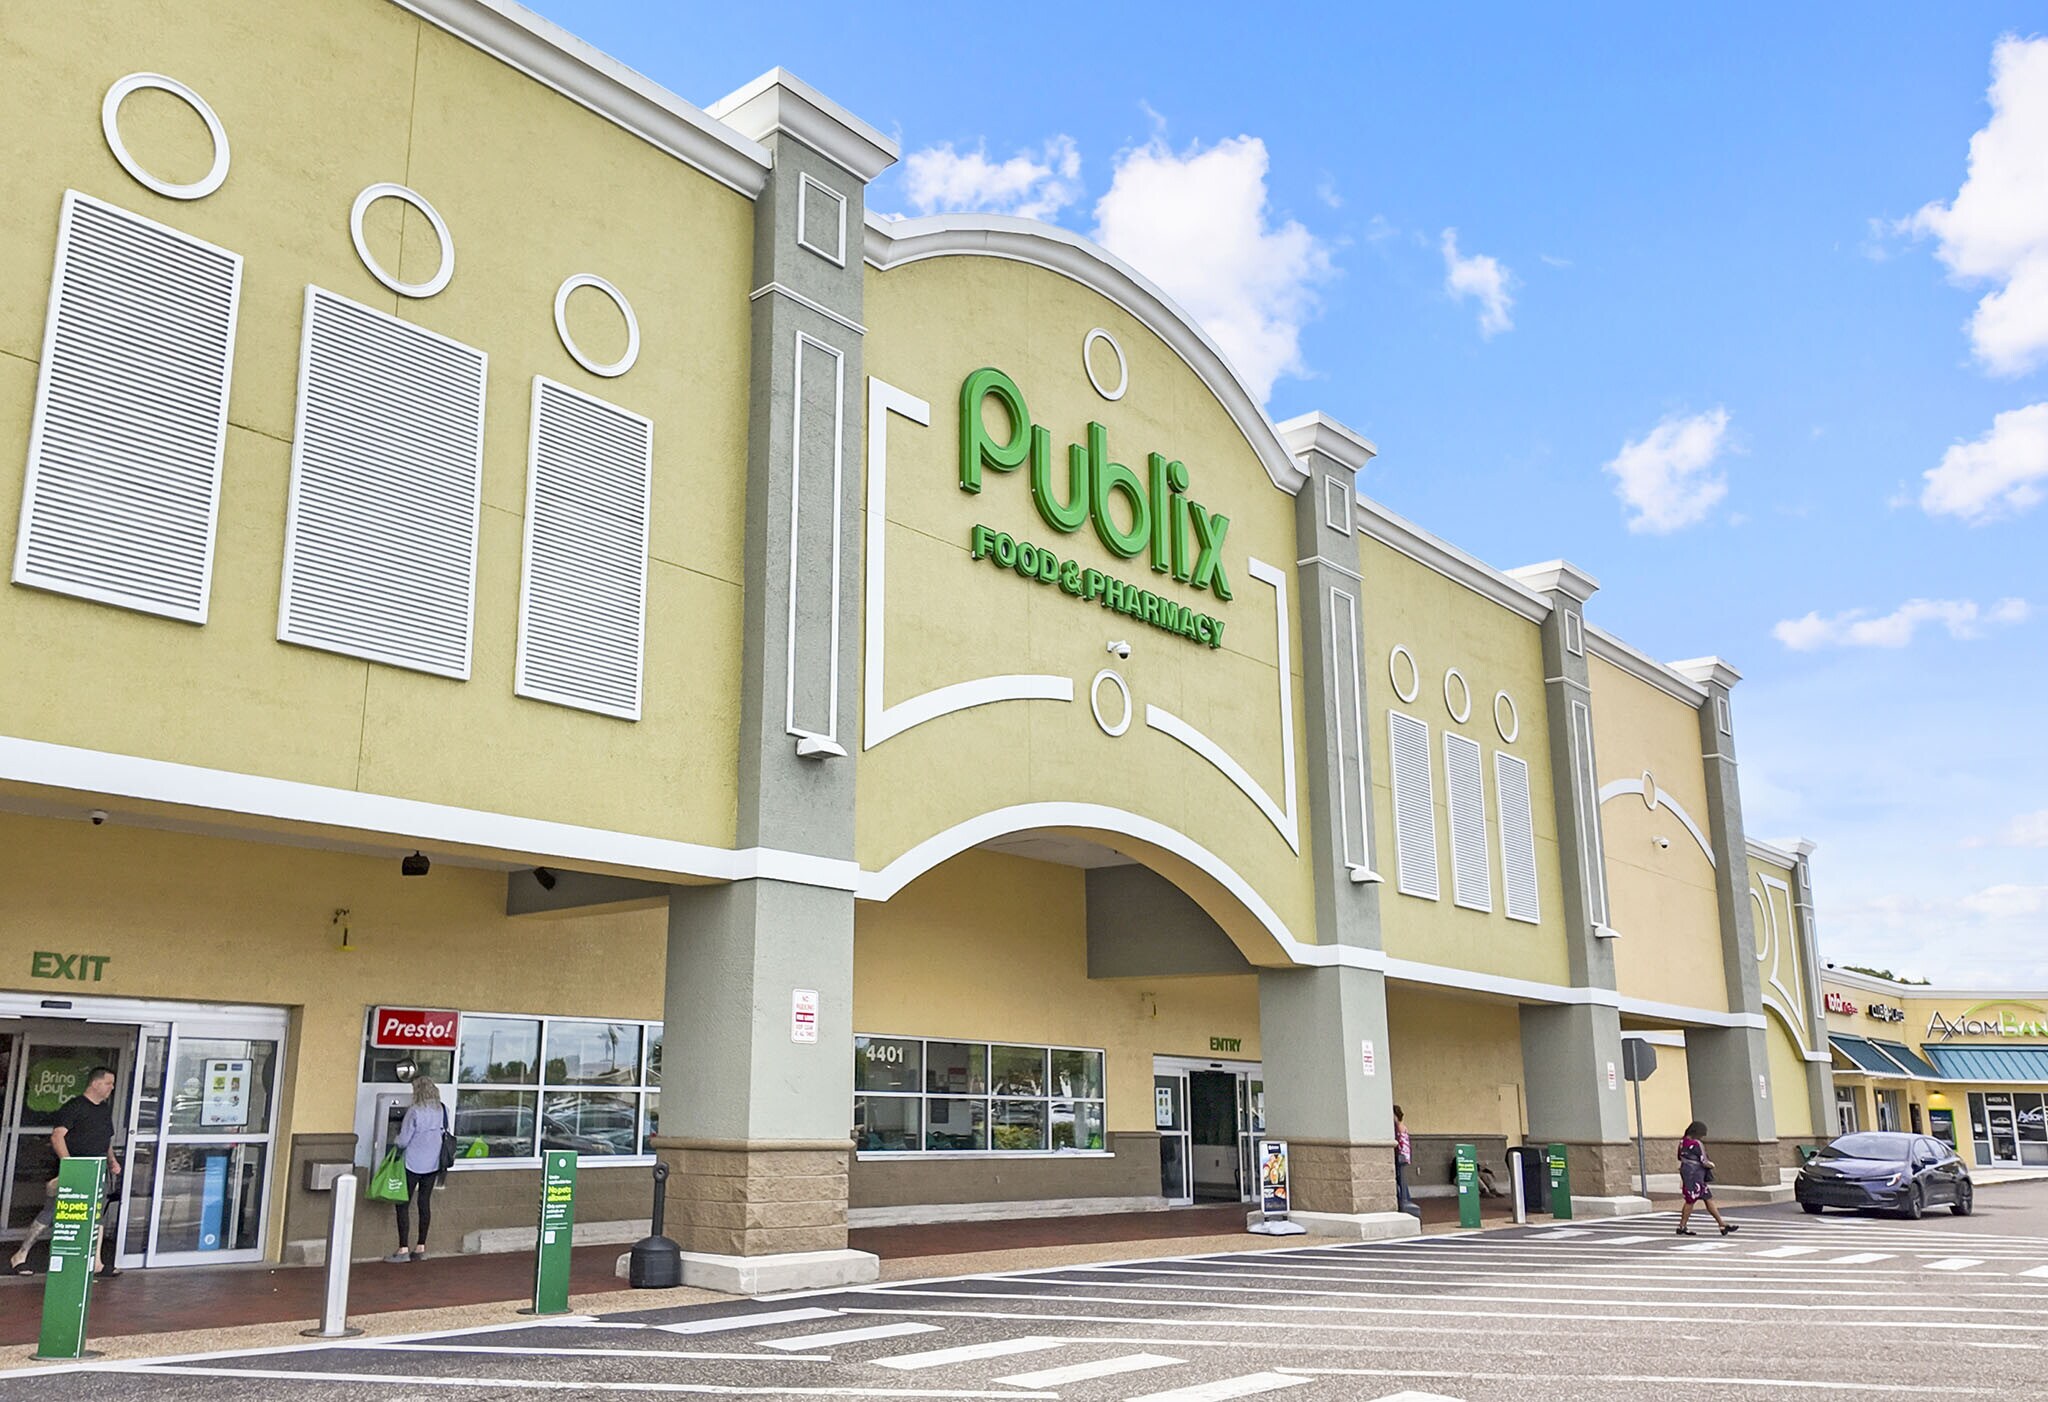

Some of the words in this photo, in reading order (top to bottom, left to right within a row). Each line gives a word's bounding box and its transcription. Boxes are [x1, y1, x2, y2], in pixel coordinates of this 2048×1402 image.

[959, 367, 1233, 601] Publix
[31, 951, 111, 981] EXIT
[382, 1018, 453, 1039] Presto!
[1209, 1036, 1242, 1052] ENTRY
[866, 1044, 904, 1063] 4401
[41, 1070, 75, 1087] Bring
[34, 1084, 65, 1097] your
[57, 1201, 68, 1210] No
[69, 1202, 88, 1212] pets
[55, 1211, 88, 1220] allowed.
